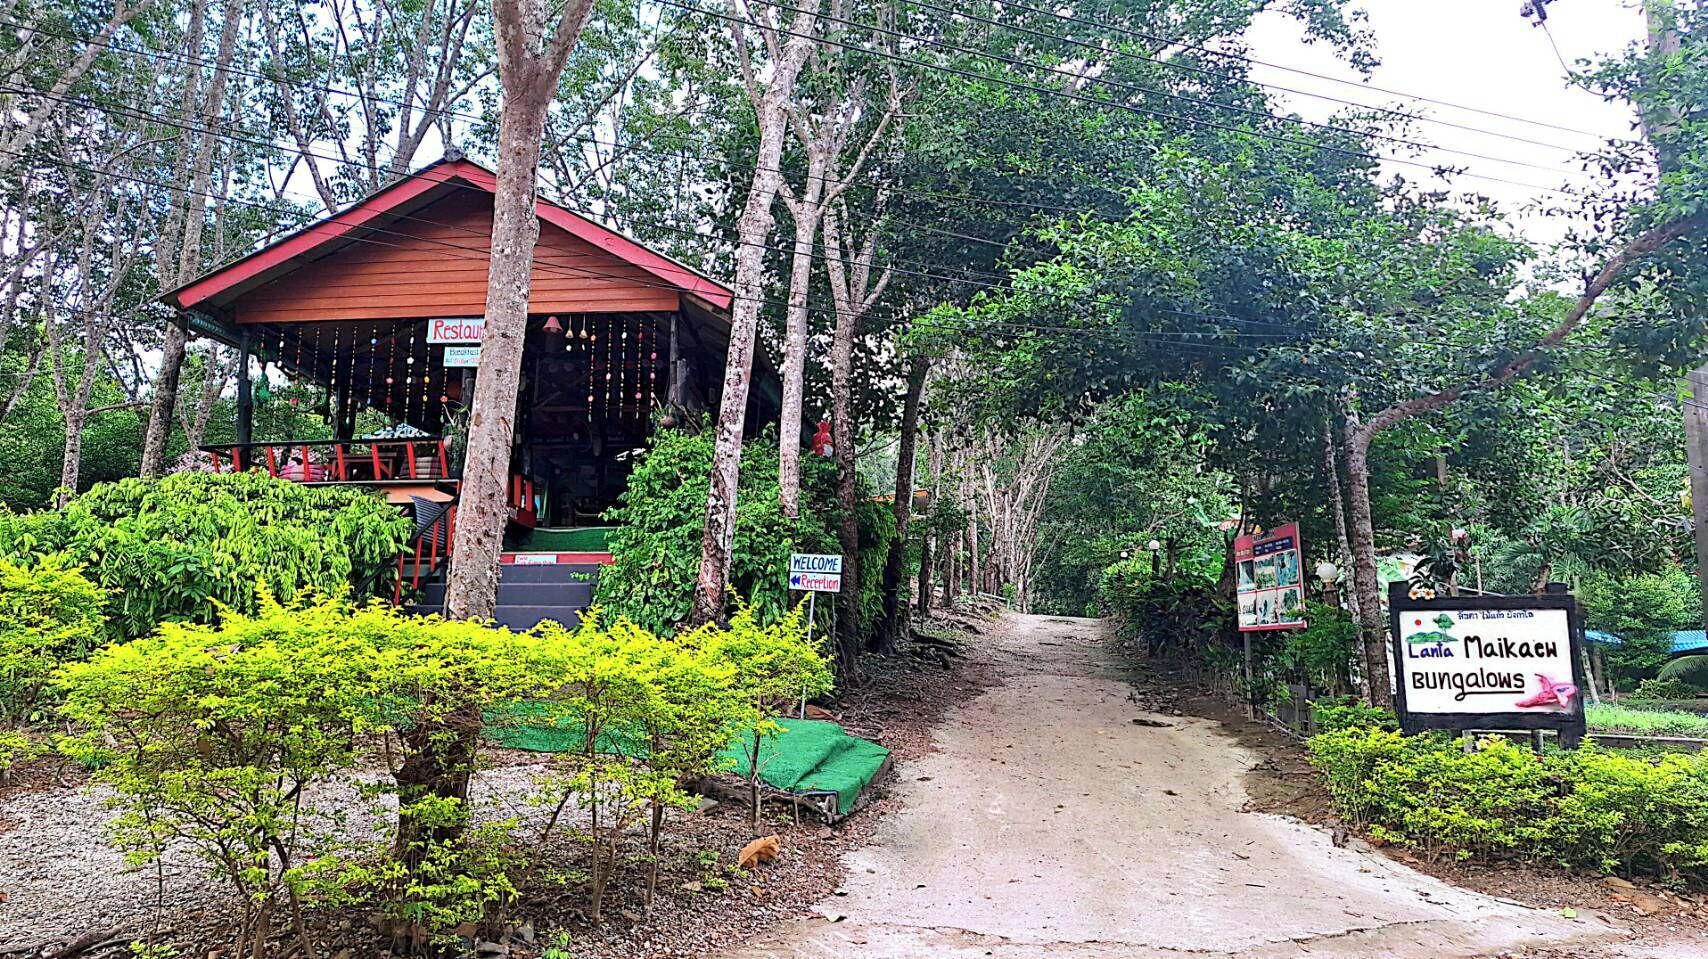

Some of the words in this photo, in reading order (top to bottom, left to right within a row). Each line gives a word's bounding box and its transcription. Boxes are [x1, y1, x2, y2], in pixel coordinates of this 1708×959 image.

[793, 556, 838, 571] WELCOME
[801, 574, 839, 590] Reception
[1408, 640, 1454, 659] Lanta
[1464, 635, 1558, 659] Maikaew
[1411, 667, 1525, 701] Bungalows
